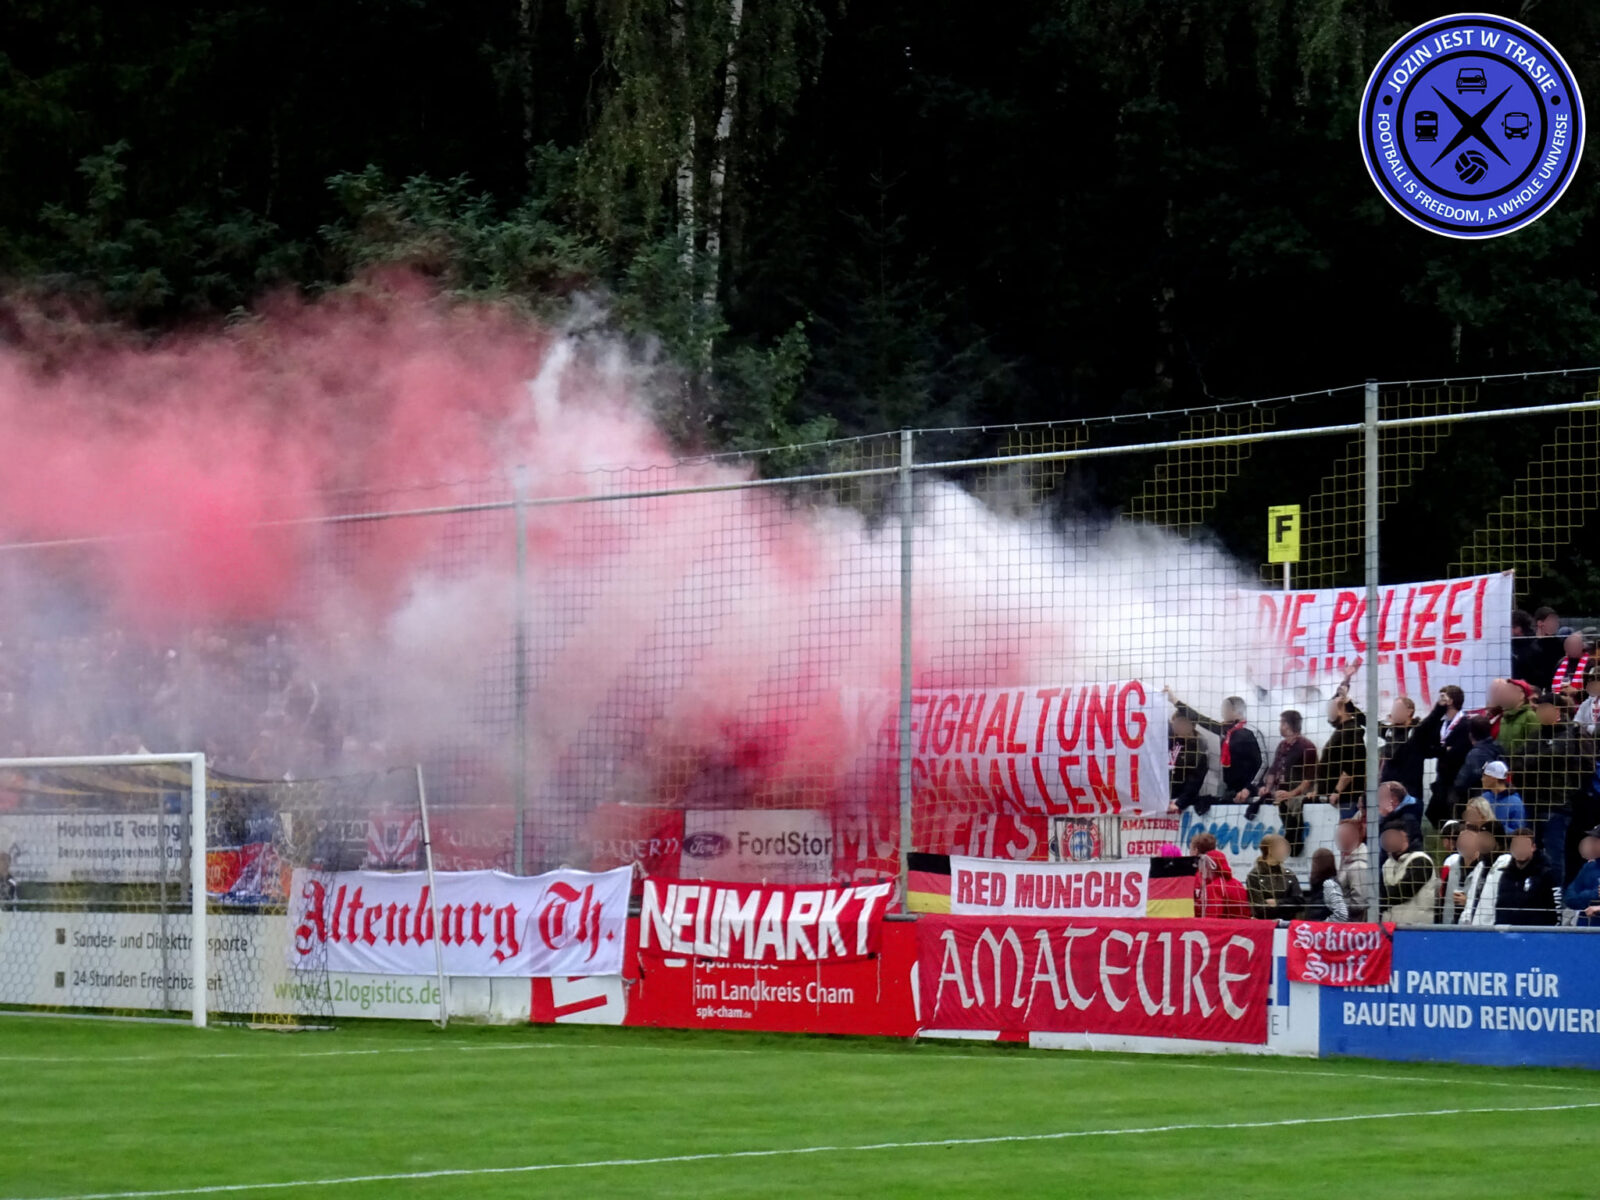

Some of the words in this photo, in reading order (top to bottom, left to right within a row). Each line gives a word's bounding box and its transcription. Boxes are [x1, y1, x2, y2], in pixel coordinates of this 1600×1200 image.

[1275, 514, 1294, 544] F
[1257, 594, 1316, 656] DIE
[1326, 578, 1488, 653] POLIZEI
[957, 870, 1007, 906] RED
[294, 880, 520, 964] Altenburg
[639, 880, 892, 961] NEUMARKT
[120, 933, 143, 949] und
[1293, 923, 1381, 951] Sektion
[932, 923, 1255, 1021] AMATEURE
[1301, 952, 1369, 983] Suff
[1406, 970, 1508, 997] PARTNER
[1515, 967, 1559, 998] FÜR
[696, 979, 716, 999] im
[721, 980, 801, 1002] Landkreis
[806, 982, 854, 1004] Cham
[696, 1005, 752, 1020] spk-cham.de
[1343, 1001, 1416, 1028] BAUEN
[1423, 1003, 1472, 1029] UND
